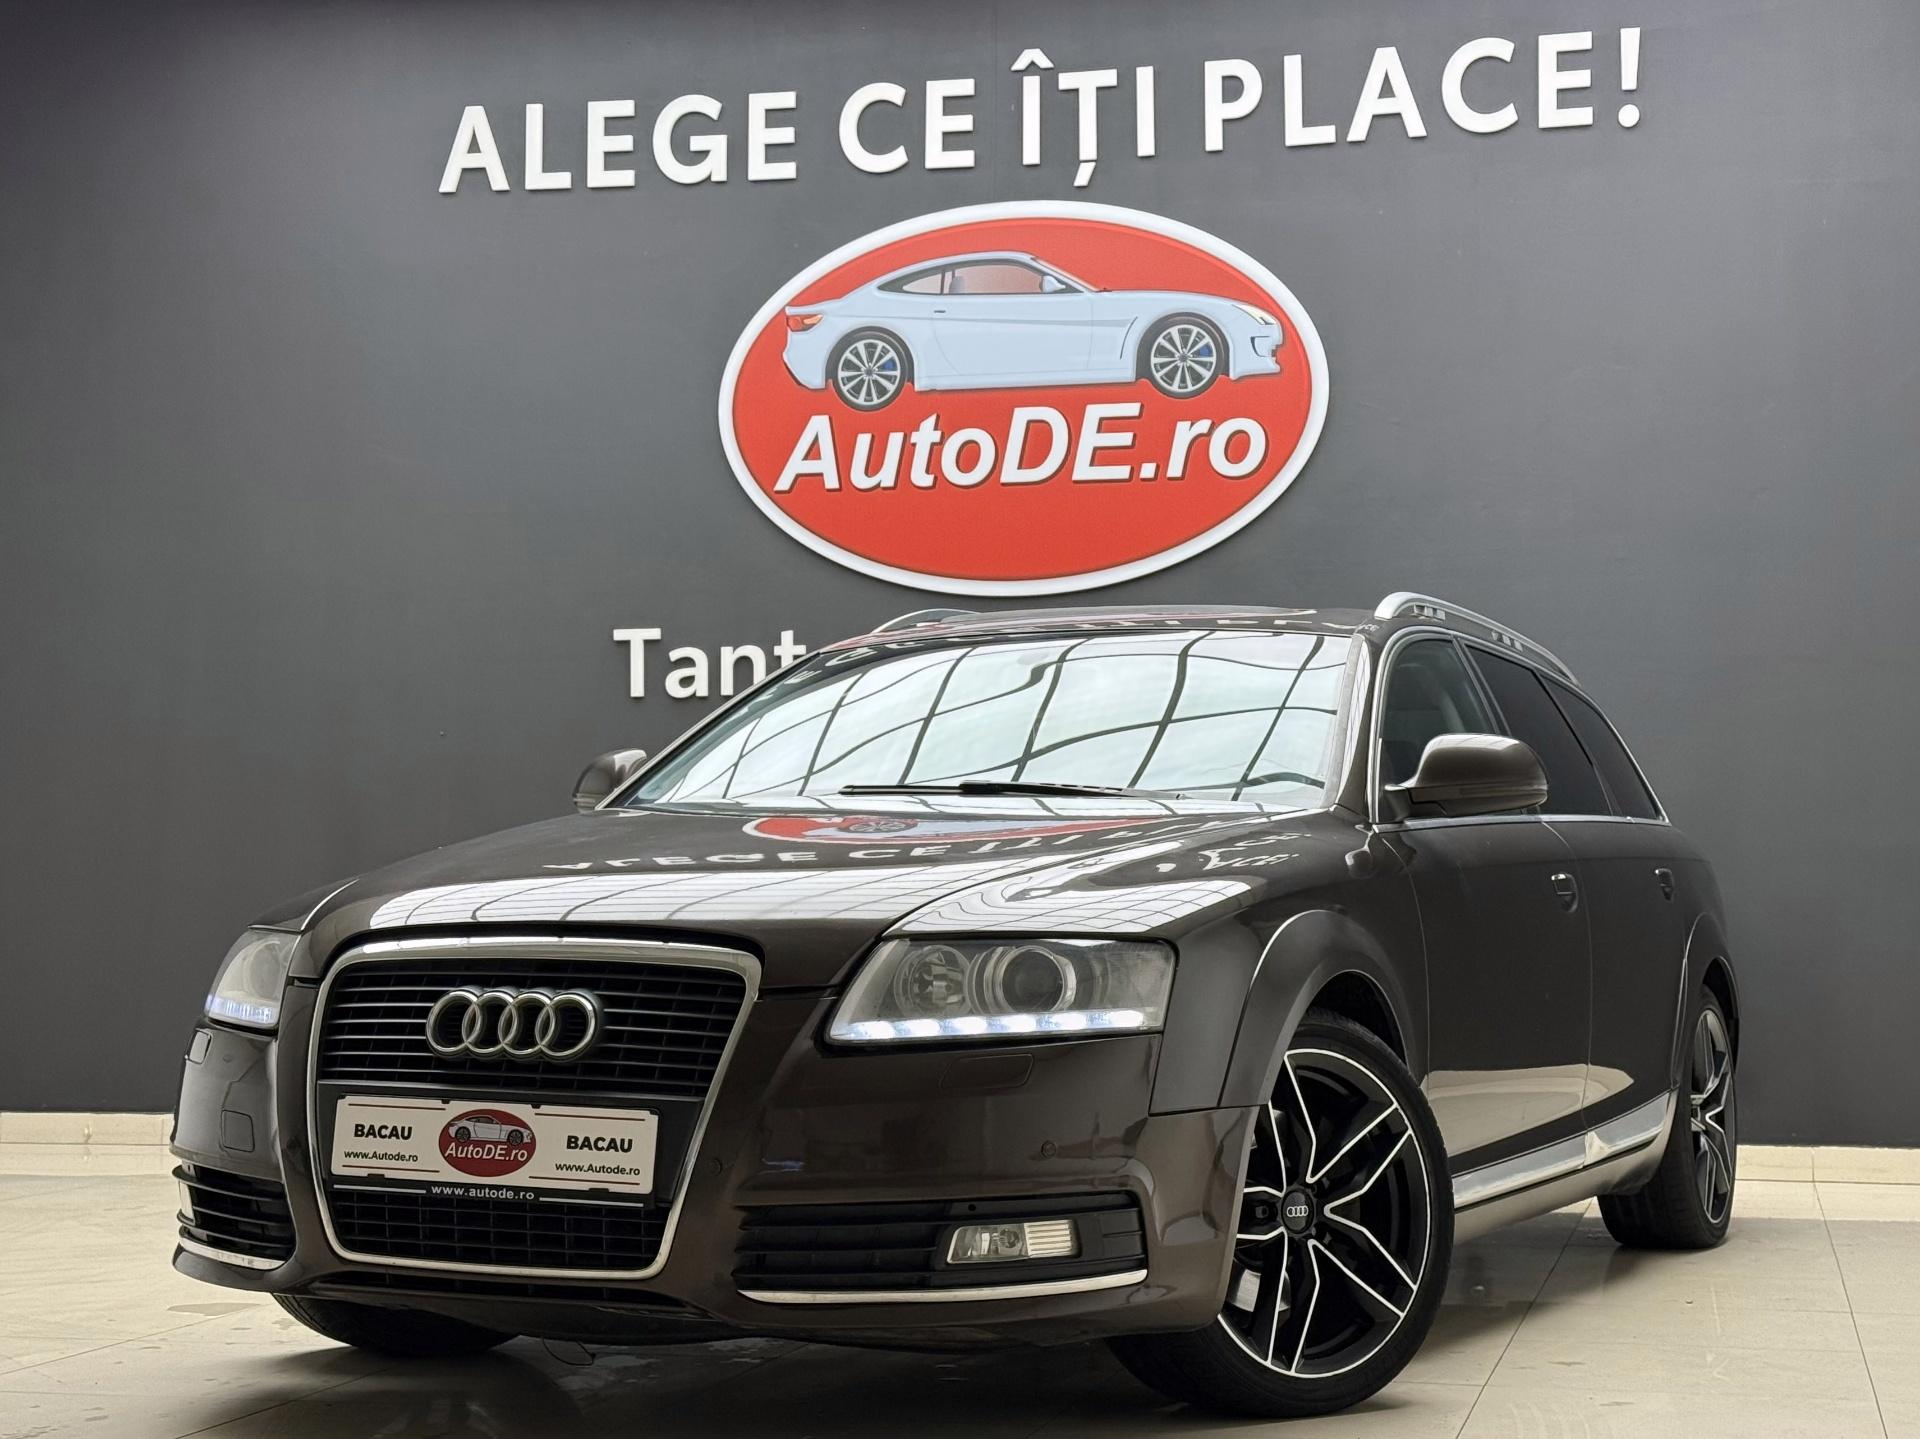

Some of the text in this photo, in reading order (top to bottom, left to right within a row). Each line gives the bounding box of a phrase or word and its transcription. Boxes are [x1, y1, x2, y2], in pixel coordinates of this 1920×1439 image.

[438, 90, 797, 194] ALEGE
[838, 78, 976, 174] CE
[1203, 26, 1642, 152] PLACE!
[773, 402, 1269, 493] AutoDE.ro
[353, 1123, 413, 1141] BACAU
[444, 1142, 528, 1162] AutoDE.ro
[566, 1134, 633, 1153] BACAU
[343, 1150, 419, 1162] www.Autode.ro
[555, 1162, 641, 1176] www.Autode.ro
[431, 1184, 535, 1200] www.autode.ro
